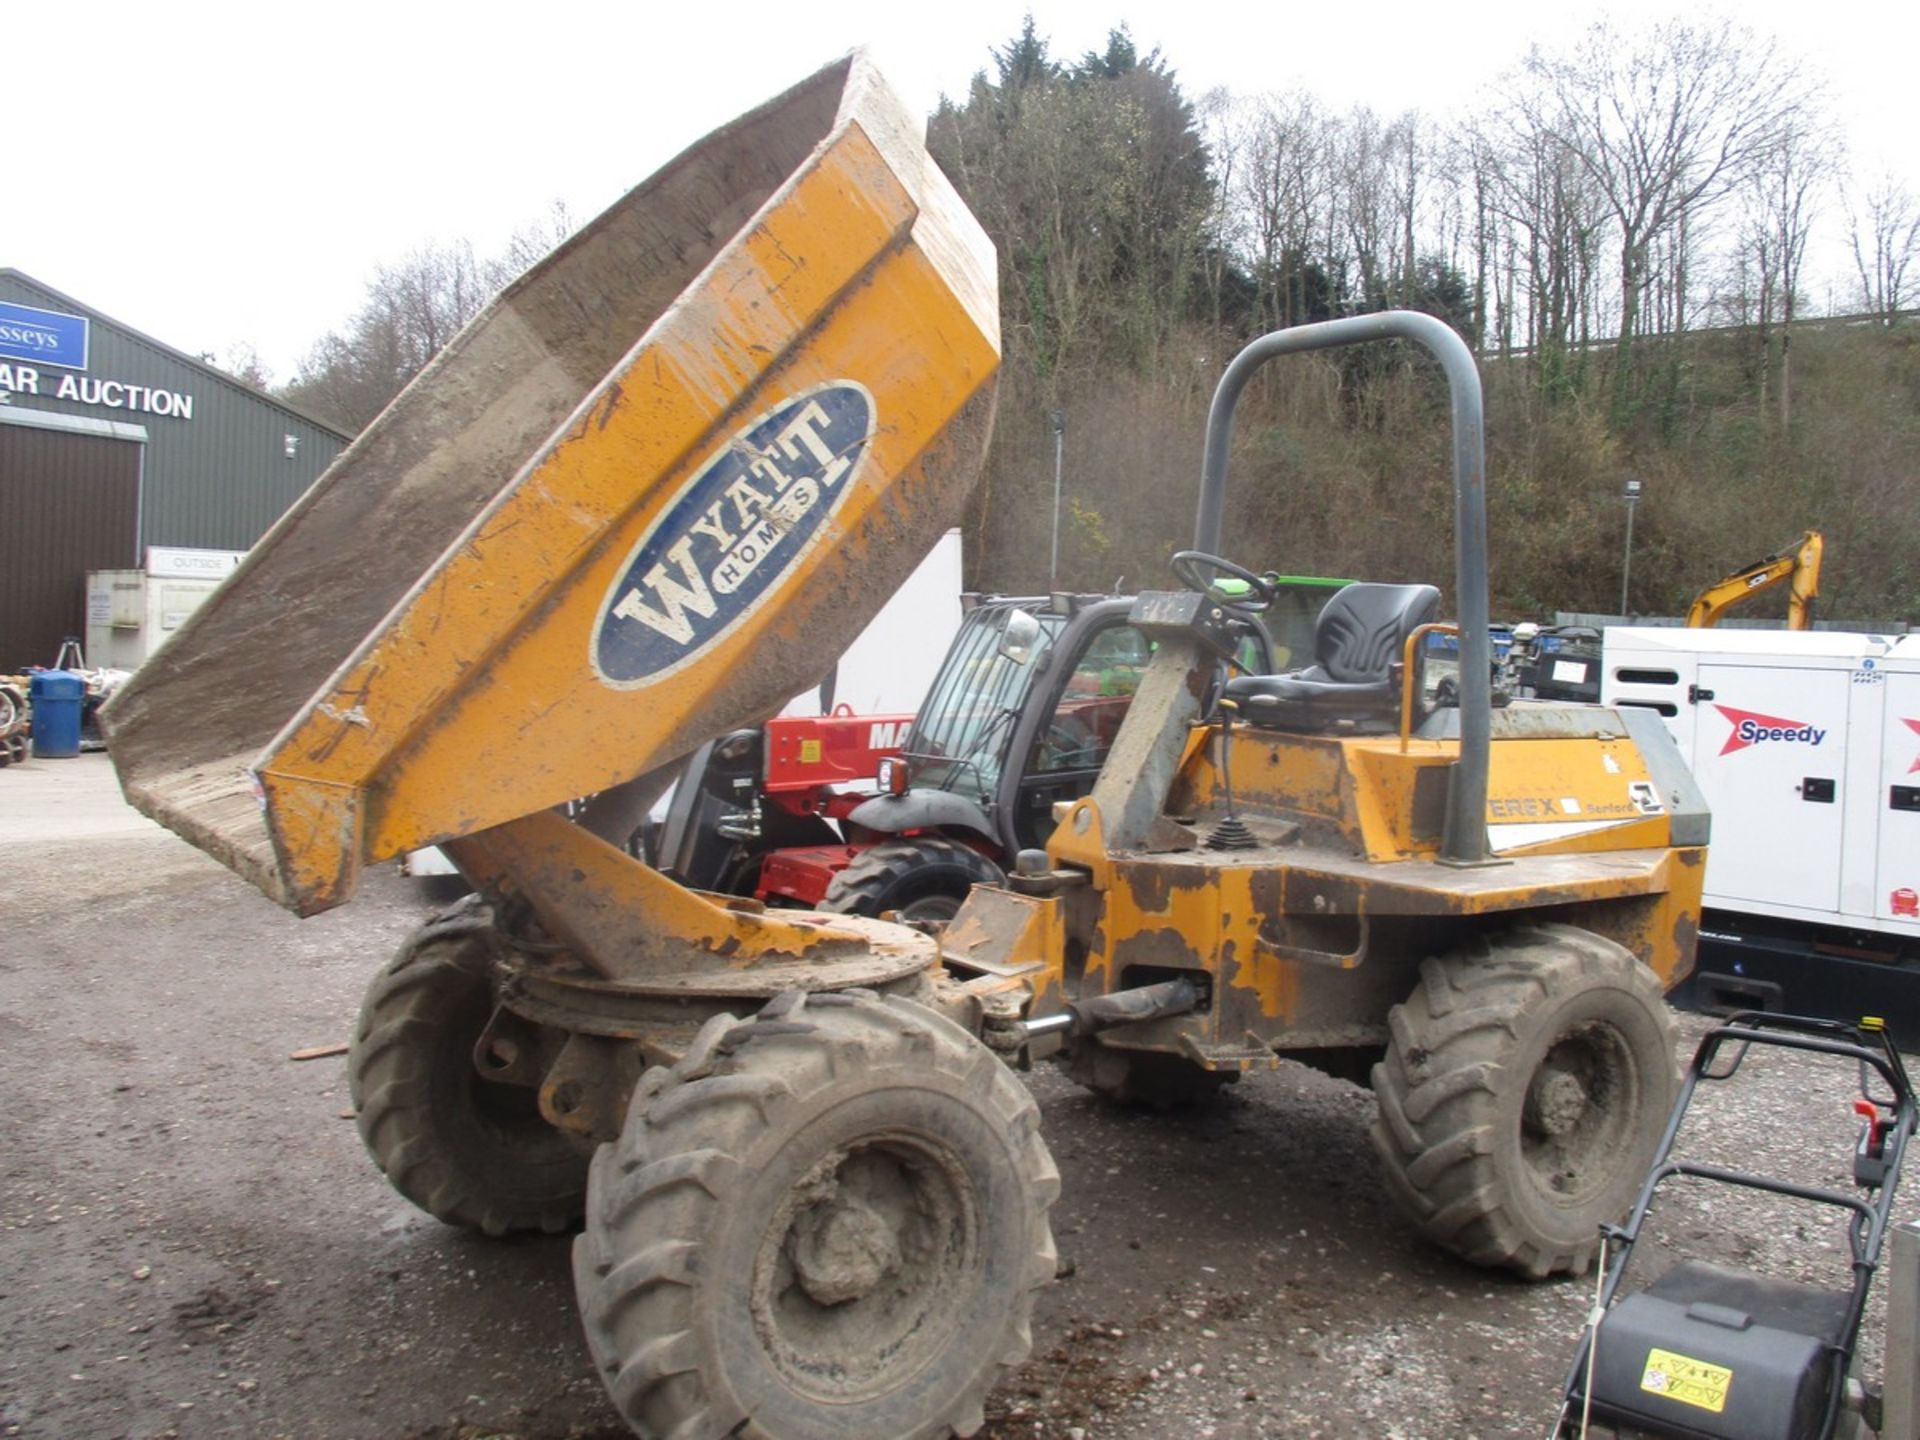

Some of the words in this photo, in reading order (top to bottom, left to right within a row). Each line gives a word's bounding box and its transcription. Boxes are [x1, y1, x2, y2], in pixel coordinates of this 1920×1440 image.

[0, 363, 38, 395] AR
[56, 374, 193, 419] AUCTION
[612, 400, 852, 646] WYATT
[1740, 721, 1826, 746] Speedy
